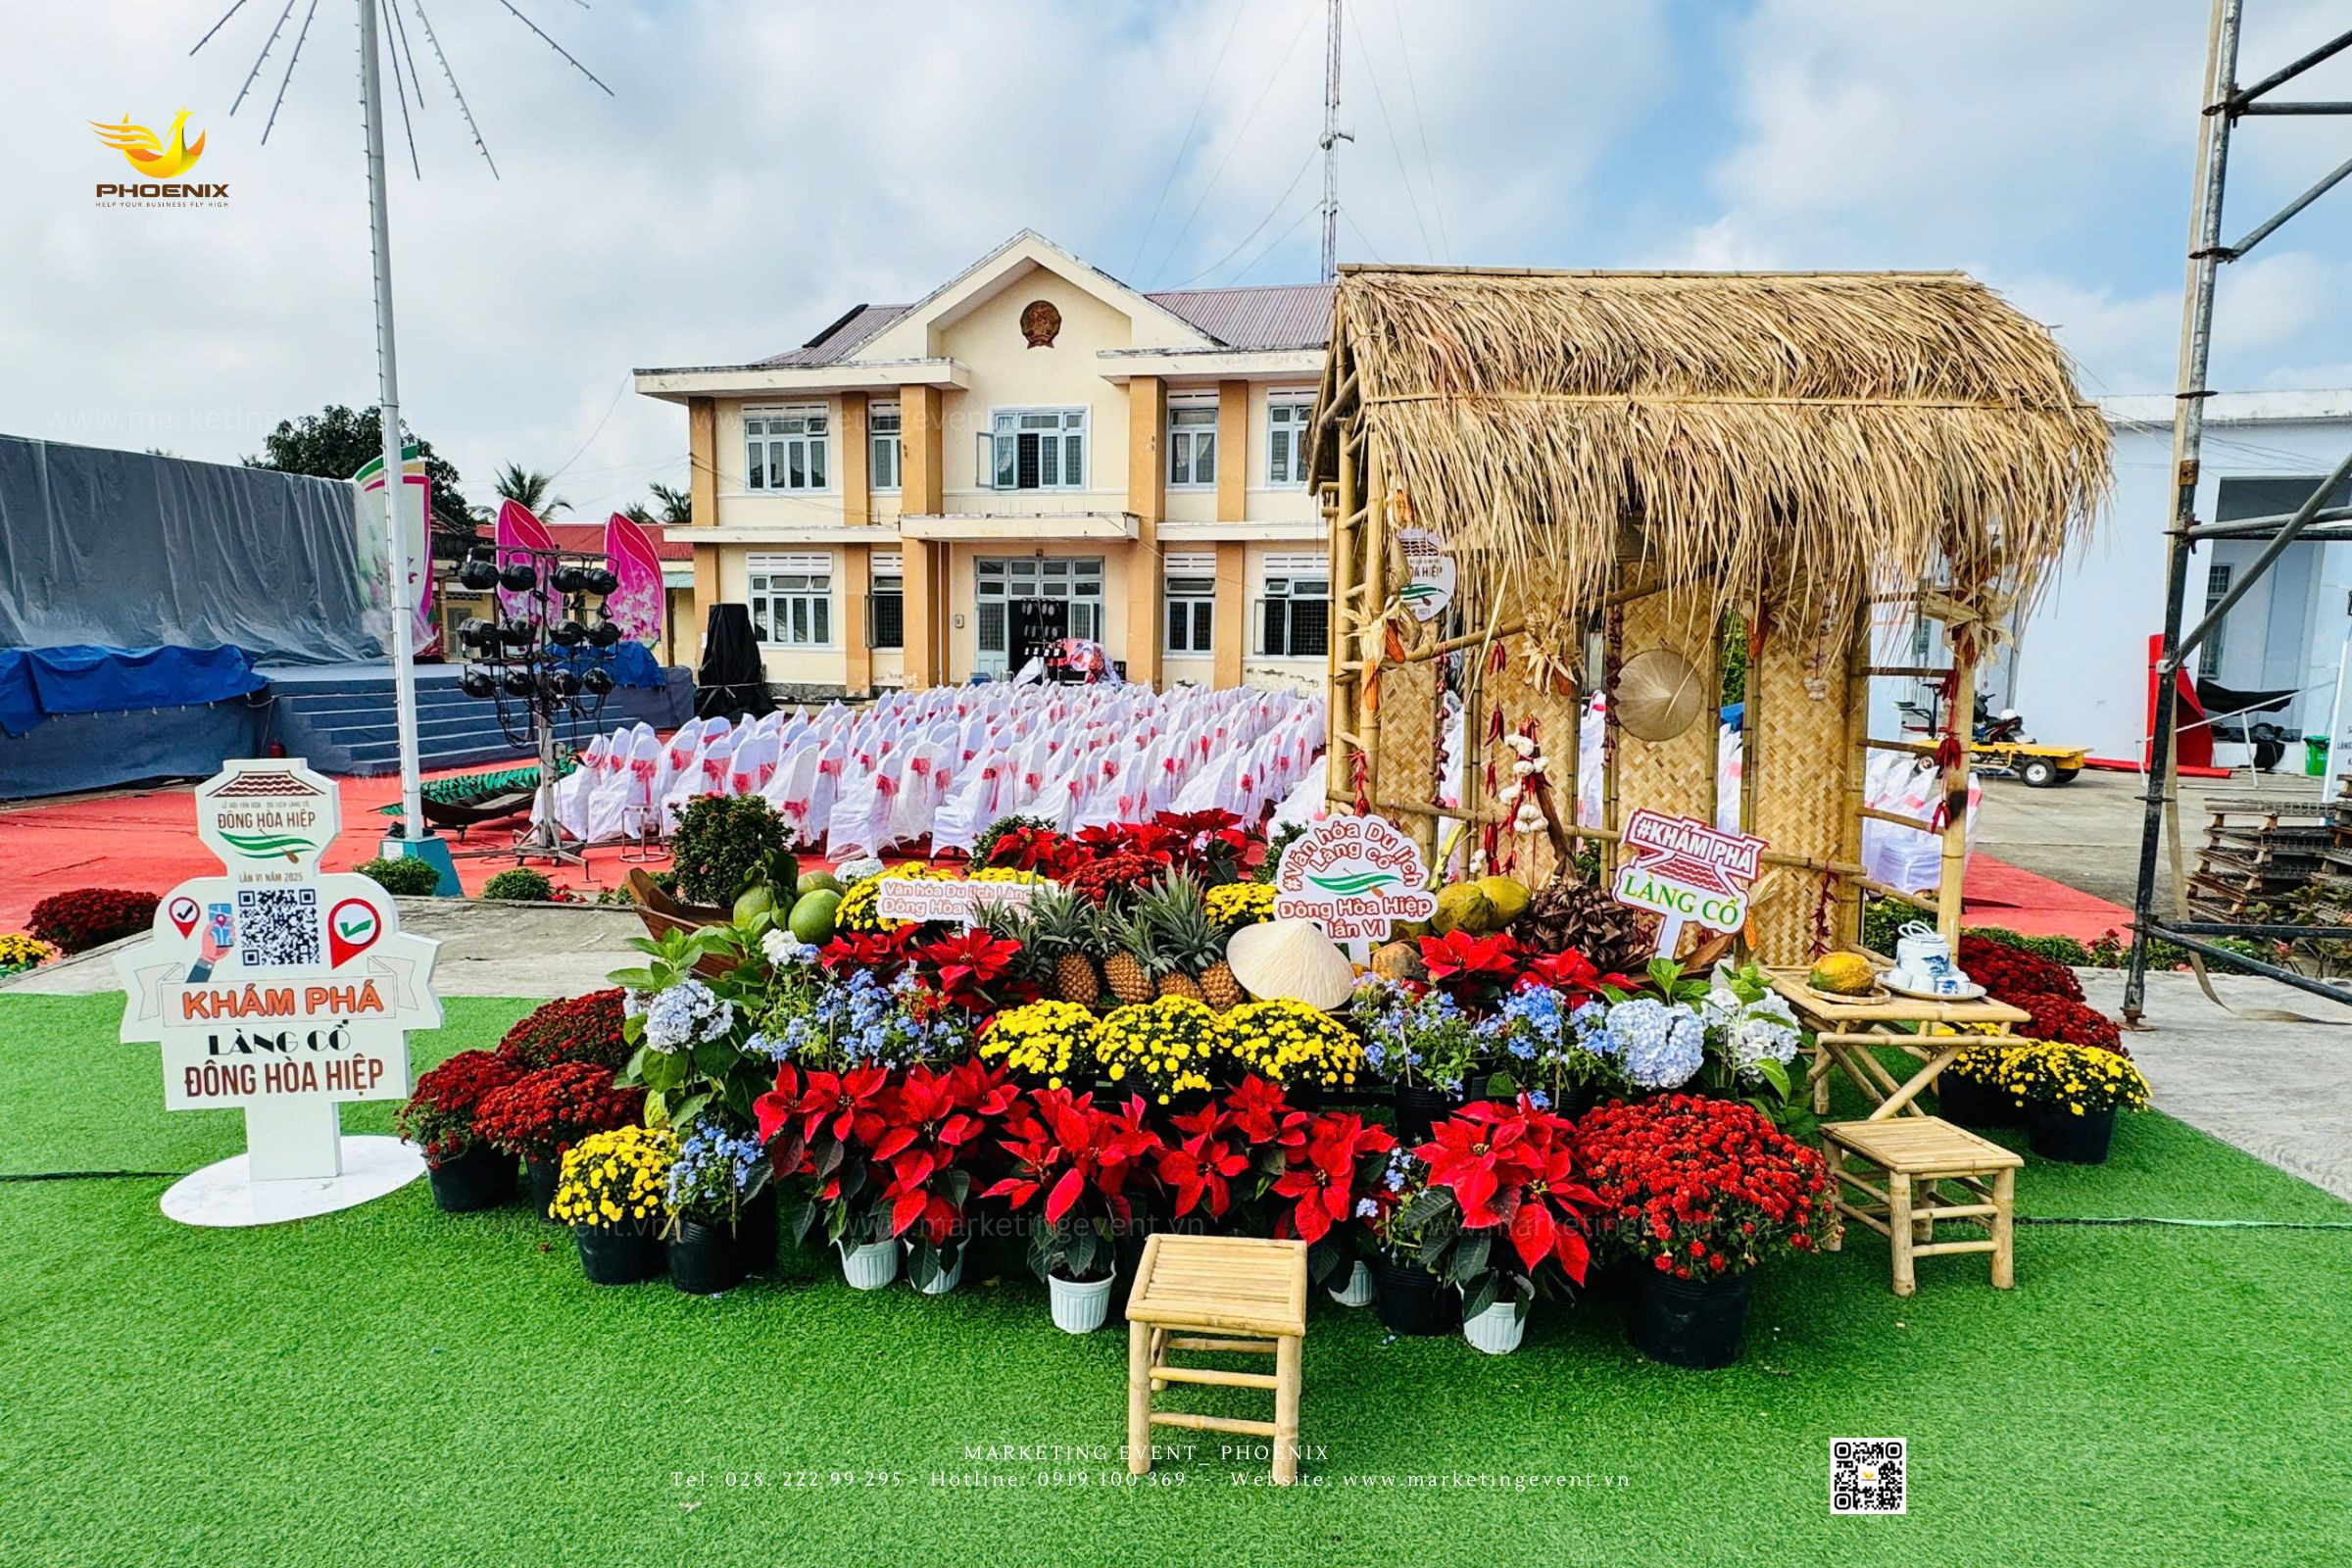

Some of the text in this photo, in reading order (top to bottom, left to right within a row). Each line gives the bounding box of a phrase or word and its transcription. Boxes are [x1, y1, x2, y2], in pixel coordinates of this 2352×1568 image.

[218, 808, 317, 831] ĐÔNG HÒA HIỆP
[1283, 819, 1424, 891] #Văn hóa Du lịch
[1309, 842, 1362, 873] Làng
[1636, 817, 1754, 873] #KHÁM PHÁ
[256, 873, 264, 883] VI
[266, 871, 282, 883] NĂM
[284, 872, 304, 883] 2025
[914, 882, 943, 898] hóa
[945, 884, 968, 900] Du
[882, 898, 926, 916] Đông
[930, 899, 963, 916] Hòa
[1279, 896, 1433, 921] Đông Hòa Hiệp
[1623, 874, 1741, 926] LÀNG CỔ
[1362, 919, 1385, 937] VI
[182, 980, 384, 1020] KHÁM PHÁ
[209, 1019, 352, 1056] LÀNG CỔ
[184, 1052, 385, 1099] ĐÔNG HÒA HIỆP
